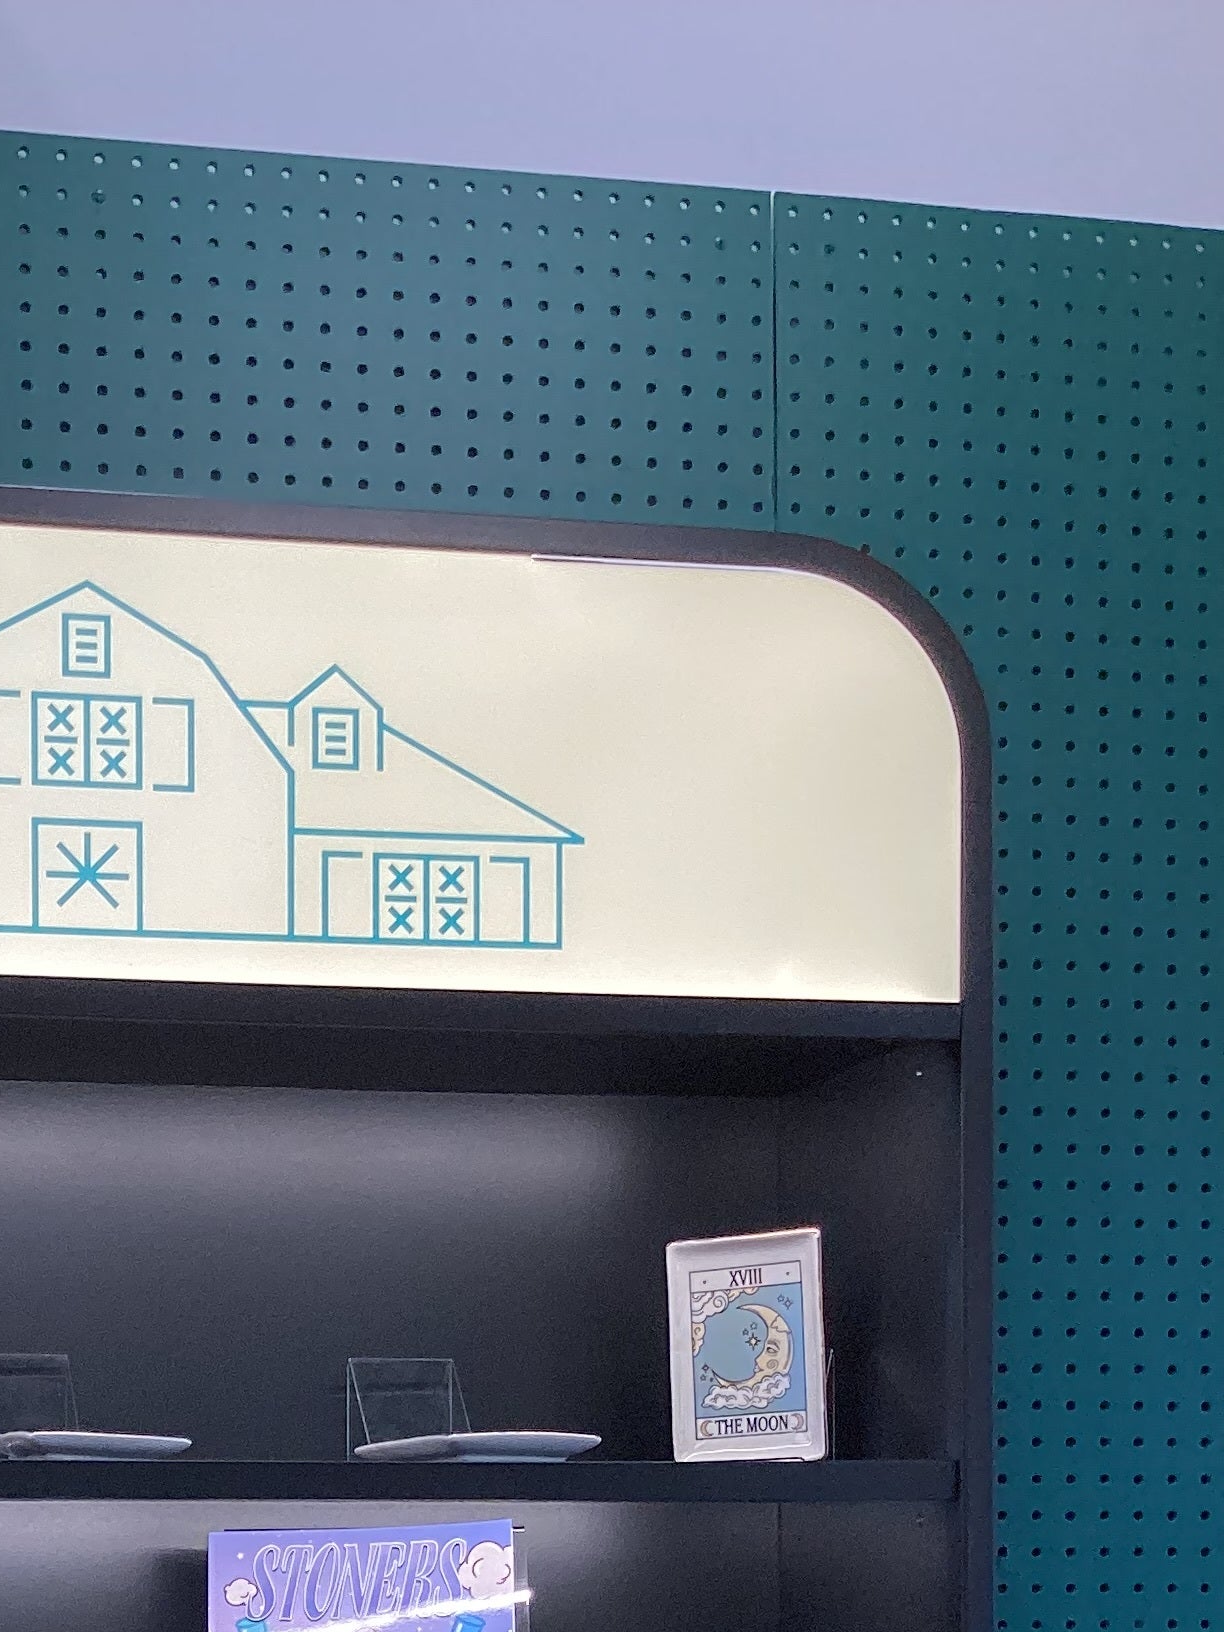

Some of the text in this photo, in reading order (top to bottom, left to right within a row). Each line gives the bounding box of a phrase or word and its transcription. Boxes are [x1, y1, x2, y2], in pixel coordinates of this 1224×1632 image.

[729, 1268, 763, 1288] XVIII
[714, 1414, 790, 1436] THE MOON
[245, 1537, 467, 1620] STONERS
